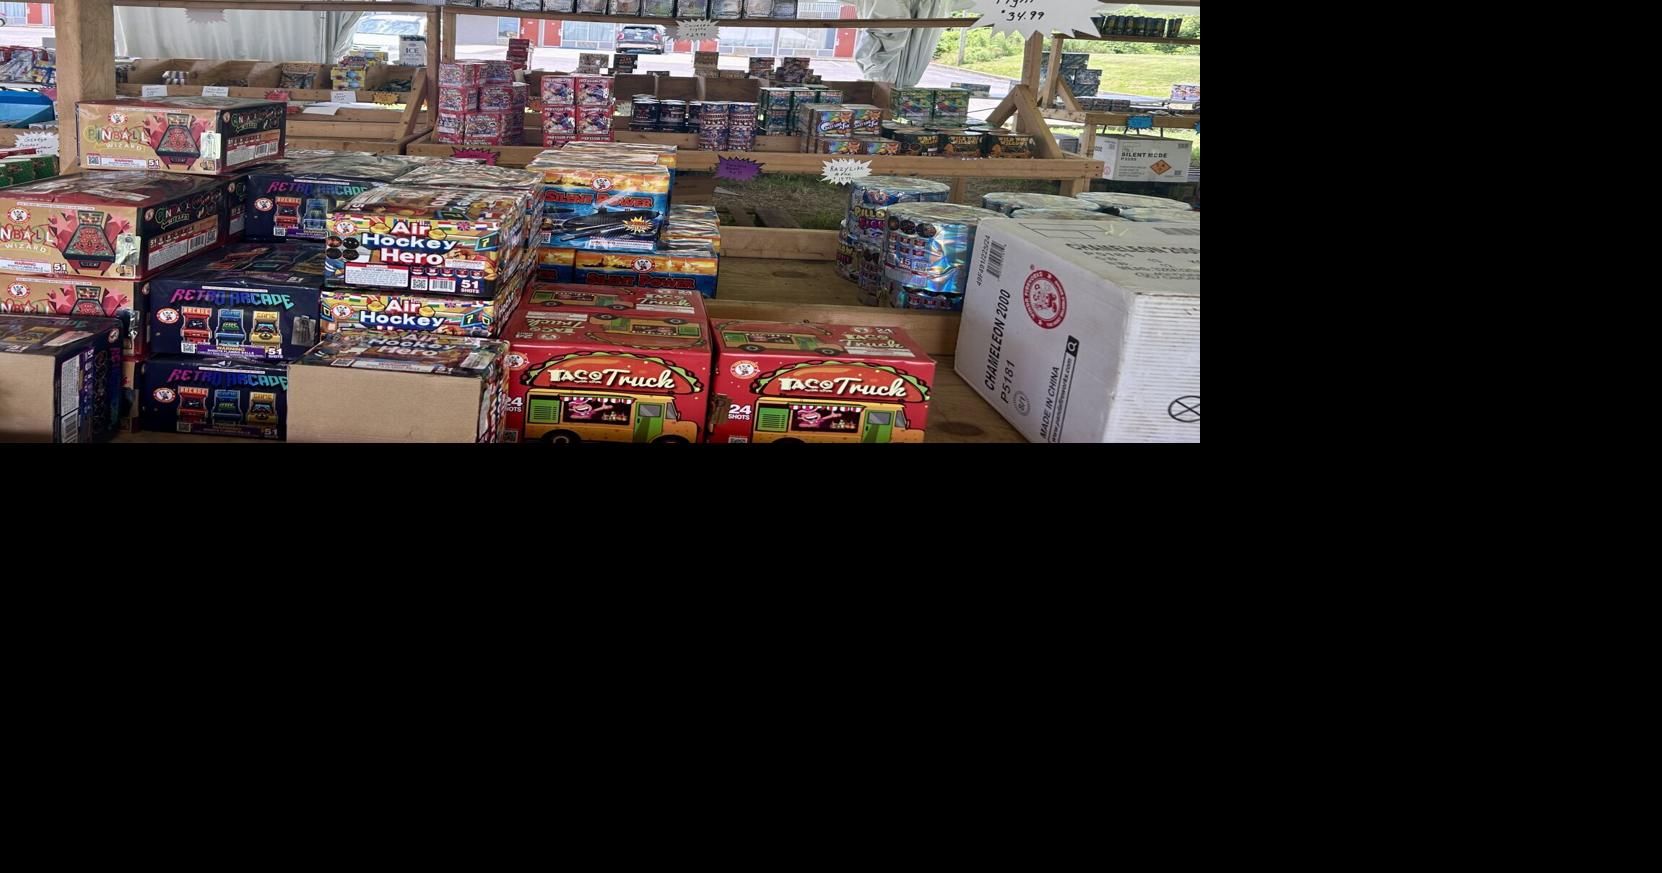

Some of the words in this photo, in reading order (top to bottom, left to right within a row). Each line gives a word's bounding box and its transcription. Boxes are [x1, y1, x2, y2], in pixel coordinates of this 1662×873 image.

[267, 181, 313, 197] RETRO
[544, 190, 593, 204] SILENT
[0, 226, 54, 244] NBALL
[391, 221, 431, 236] Air
[5, 244, 47, 253] WIZARD
[361, 233, 458, 252] Hockey
[381, 248, 443, 265] Hero
[460, 279, 479, 289] 51
[639, 274, 695, 289] POWER
[170, 288, 225, 306] RETRO
[229, 292, 295, 310] ARCADE
[385, 299, 422, 313] Air
[361, 311, 446, 328] Hockey
[368, 338, 457, 350] Hockey
[984, 317, 1006, 391] CHAMELEON
[996, 288, 1011, 319] 2000
[378, 345, 439, 356] Hero
[167, 368, 222, 386] RETRO
[226, 373, 287, 392] ARCADE
[548, 368, 603, 382] TACO
[602, 368, 675, 389] Truck
[1000, 359, 1015, 404] P5181
[1048, 366, 1060, 398] CHINA
[779, 377, 834, 391] TACO
[834, 377, 907, 397] Truck
[729, 404, 751, 415] 24
[1046, 397, 1055, 411] IN
[728, 413, 751, 421] SHOTS
[1040, 411, 1052, 440] MADE
